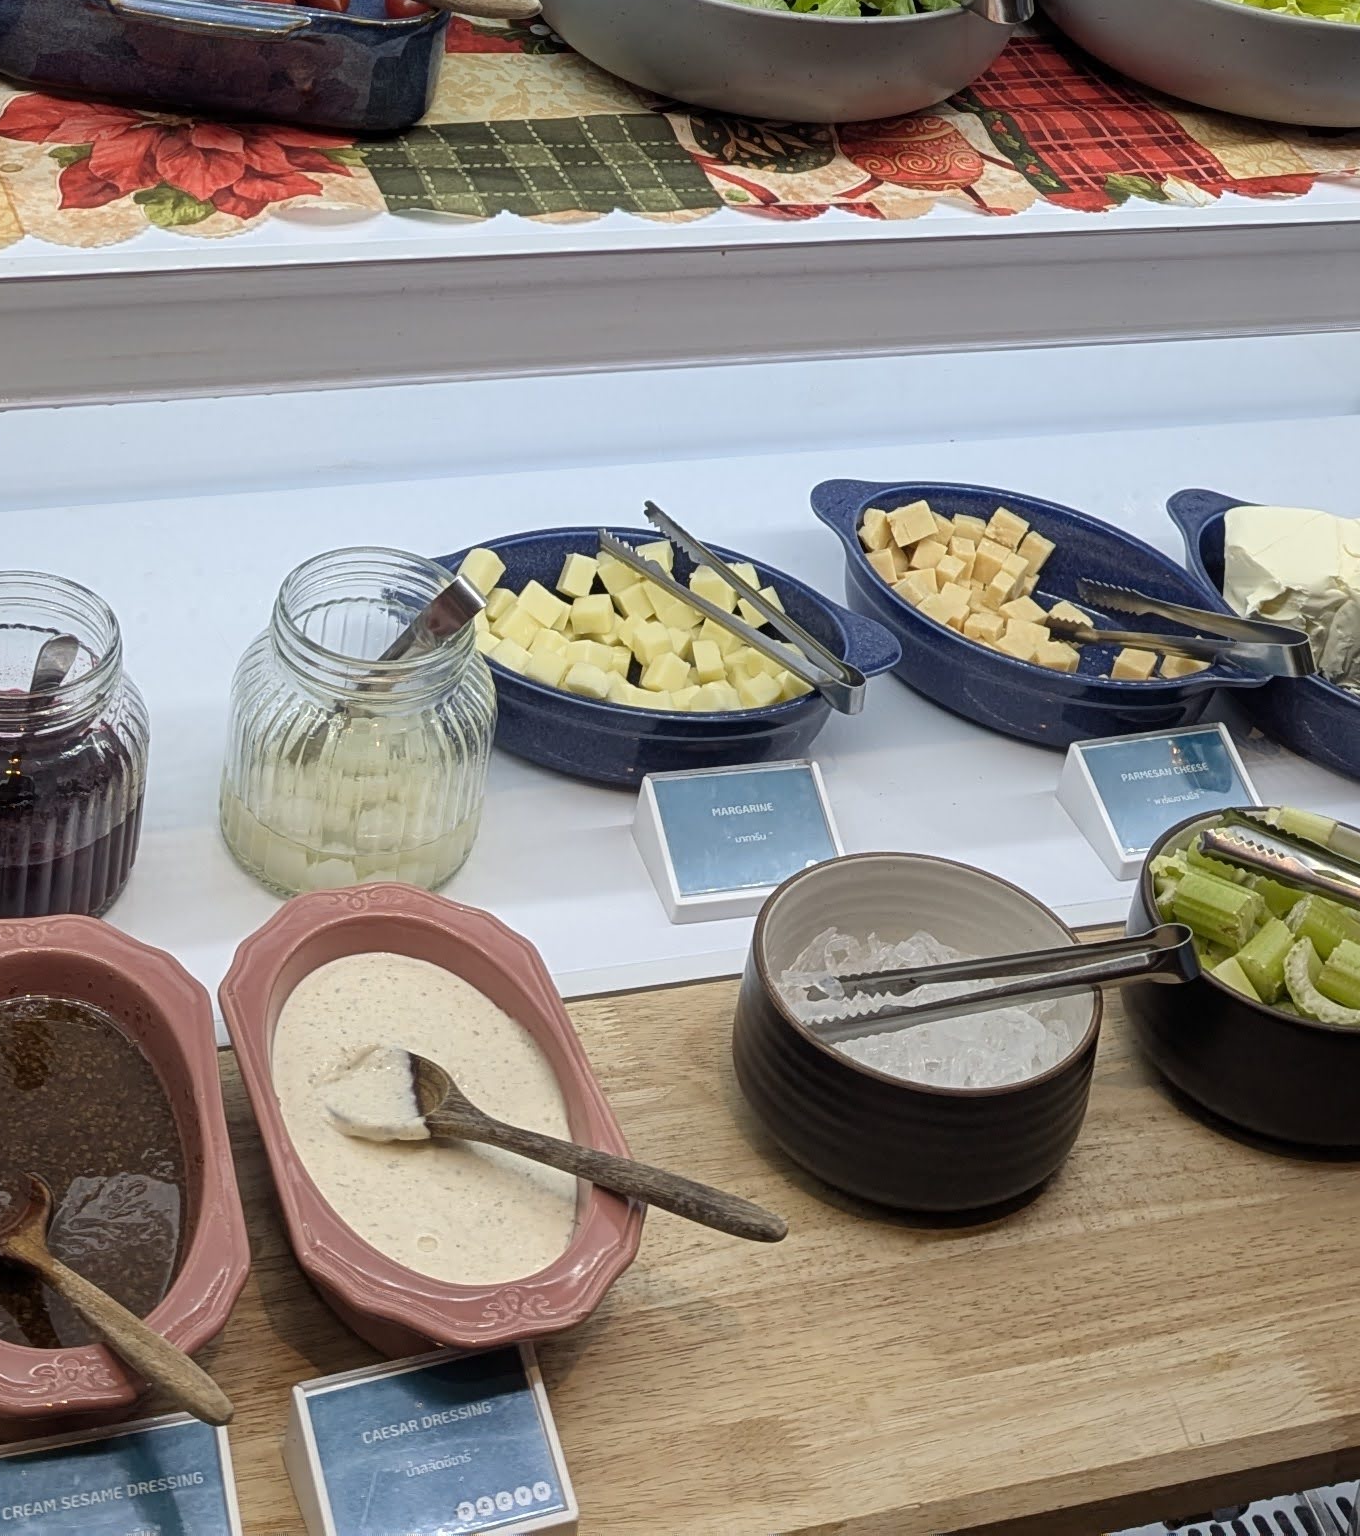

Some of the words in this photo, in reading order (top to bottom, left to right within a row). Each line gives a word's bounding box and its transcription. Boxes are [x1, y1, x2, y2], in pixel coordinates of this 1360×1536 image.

[1121, 767, 1172, 782] PARMESAN
[1174, 762, 1209, 775] CHEESE
[712, 802, 774, 816] MARGARINE
[362, 1419, 420, 1444] CAESAR
[422, 1401, 492, 1428] DRESSING
[2, 1499, 57, 1521] CREAM
[60, 1487, 124, 1511] SESAME
[127, 1471, 204, 1498] DRESSING
